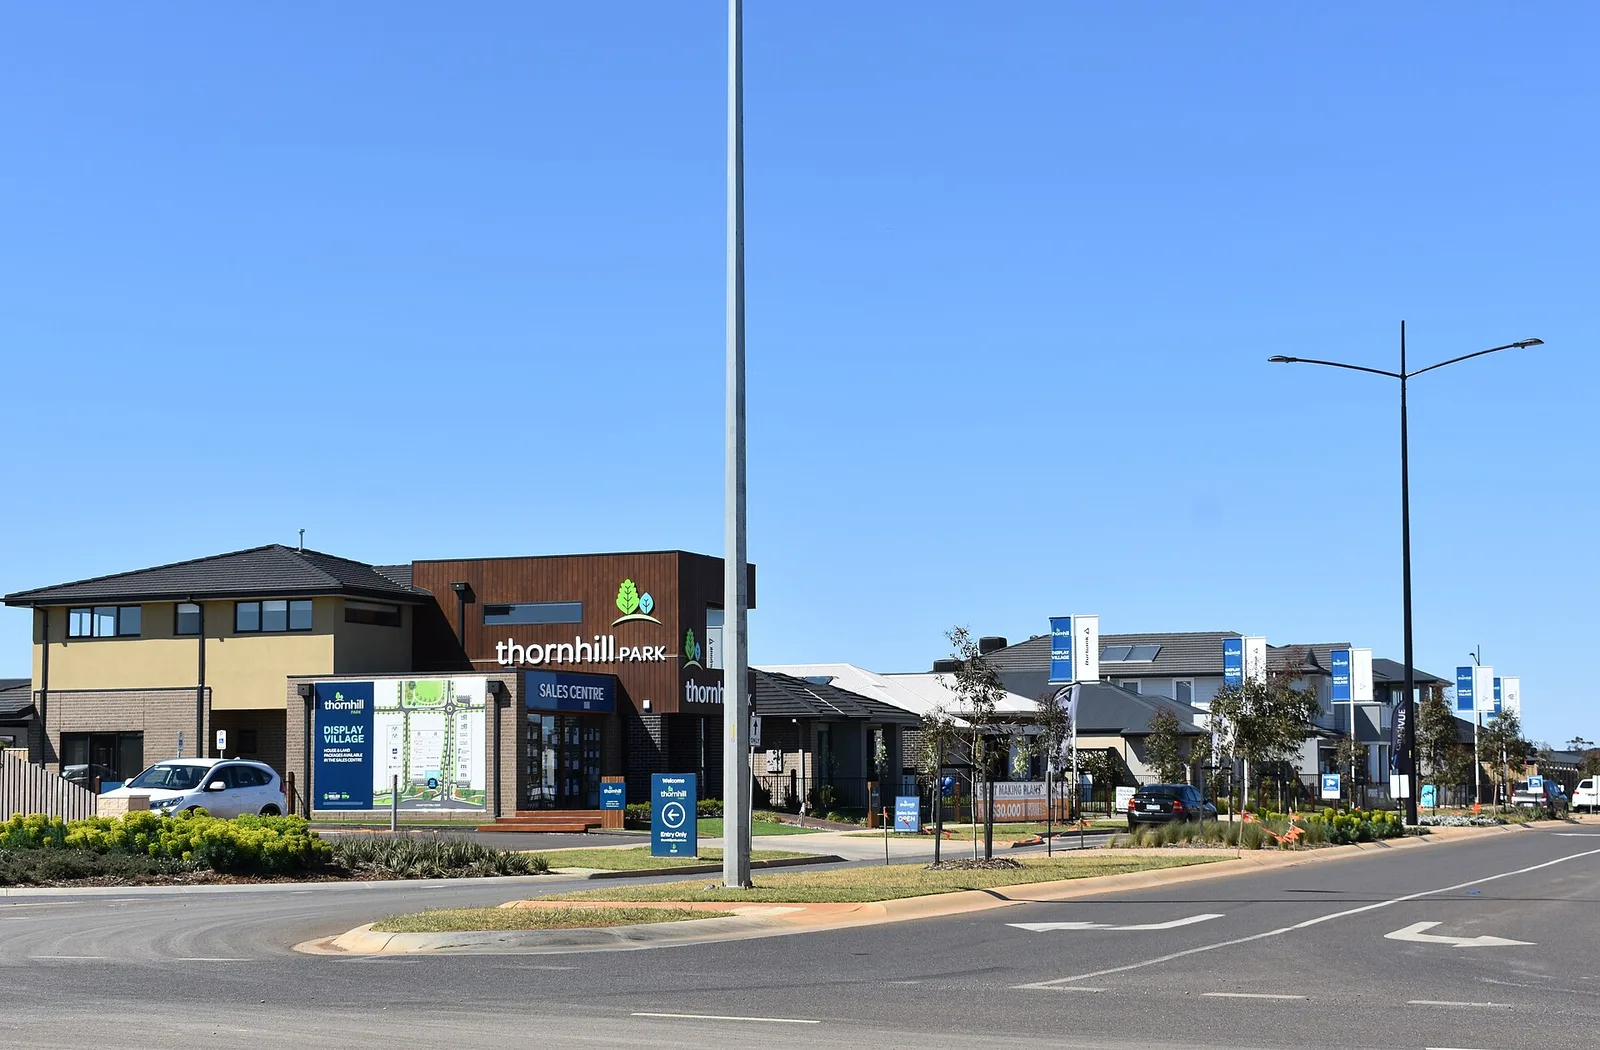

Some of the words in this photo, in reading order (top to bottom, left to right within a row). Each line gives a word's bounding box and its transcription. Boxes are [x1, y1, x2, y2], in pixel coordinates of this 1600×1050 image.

[496, 635, 615, 665] thornhill
[619, 646, 666, 662] PARK
[539, 683, 569, 699] SALES
[569, 684, 604, 701] CENTRE
[685, 678, 724, 704] thornh
[324, 699, 365, 711] thornhill
[323, 725, 364, 735] DISPLAY
[323, 735, 365, 744] VILLAGE
[660, 790, 687, 798] thornhill
[999, 784, 1022, 796] MAKING
[674, 831, 687, 839] Only
